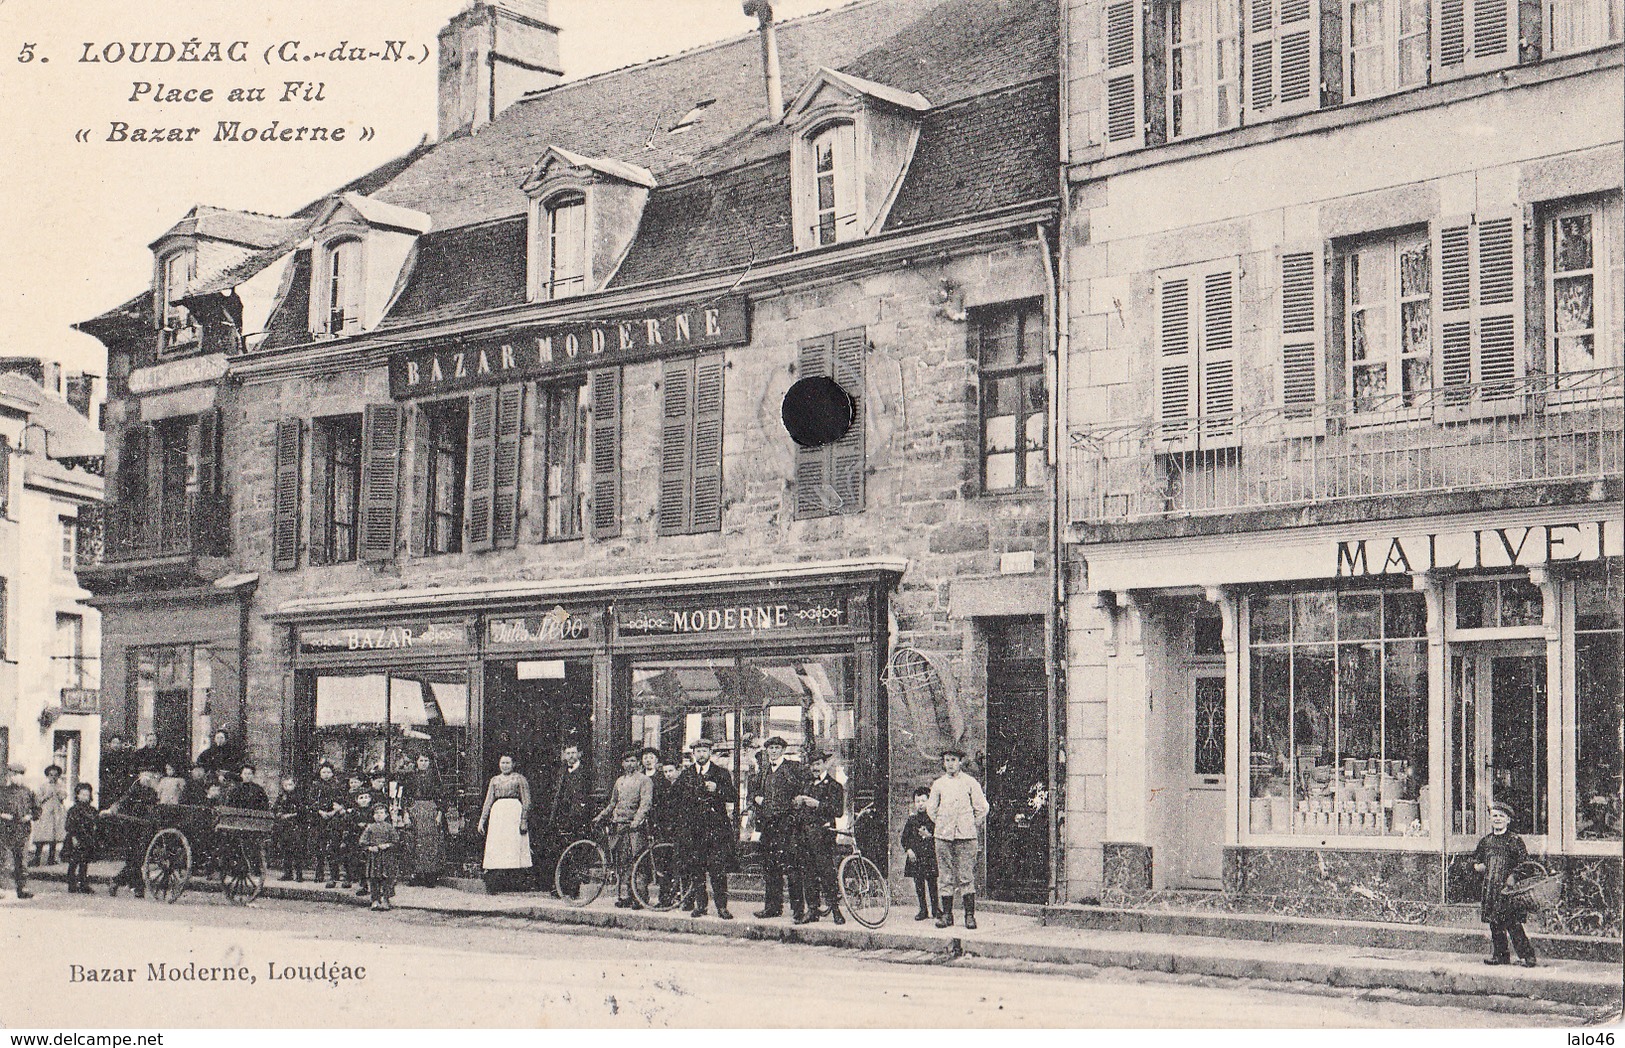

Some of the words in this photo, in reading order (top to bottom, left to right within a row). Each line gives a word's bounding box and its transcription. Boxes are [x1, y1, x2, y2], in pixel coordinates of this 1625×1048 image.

[406, 343, 518, 386] BAZAR
[536, 309, 721, 363] MODERNE
[347, 628, 413, 651] BAZAR
[672, 604, 789, 633] MODERNE
